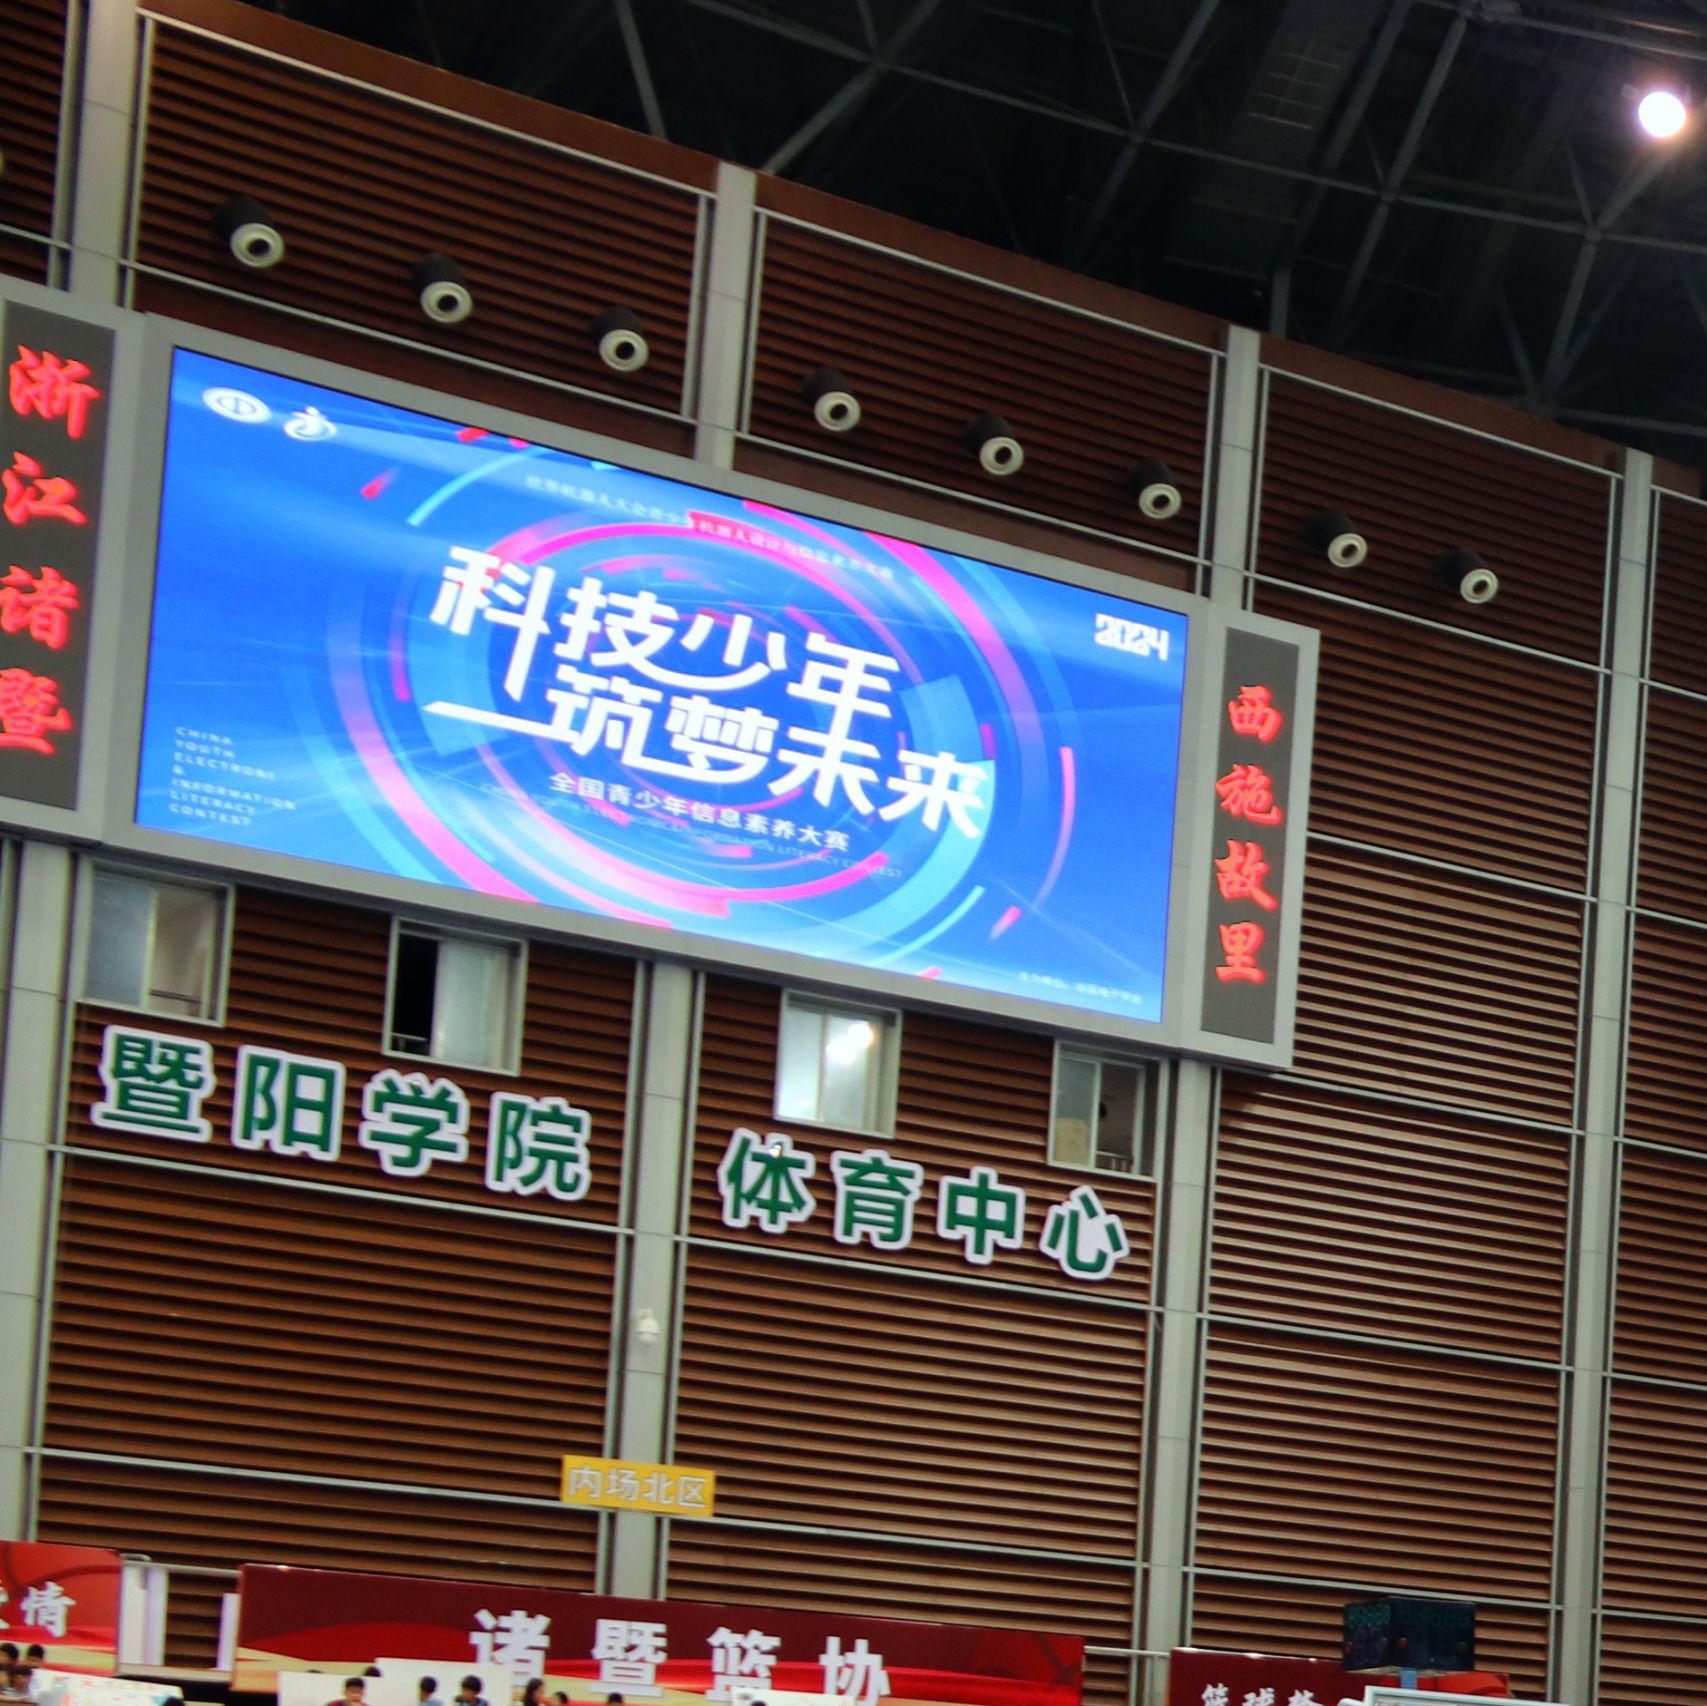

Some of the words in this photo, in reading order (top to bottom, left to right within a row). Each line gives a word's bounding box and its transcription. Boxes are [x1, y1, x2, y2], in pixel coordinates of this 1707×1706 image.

[0, 344, 99, 756] 浙江诸暨
[428, 544, 901, 722] 科技少年
[1094, 611, 1171, 663] 2024
[424, 667, 996, 840] 筑梦未来
[548, 771, 851, 853] 全国青少年信息素养大赛
[1214, 684, 1283, 985] 西施故里
[89, 1023, 593, 1202] 暨阳学院
[717, 1125, 1131, 1282] 体育中心
[566, 1463, 711, 1512] 内场北区
